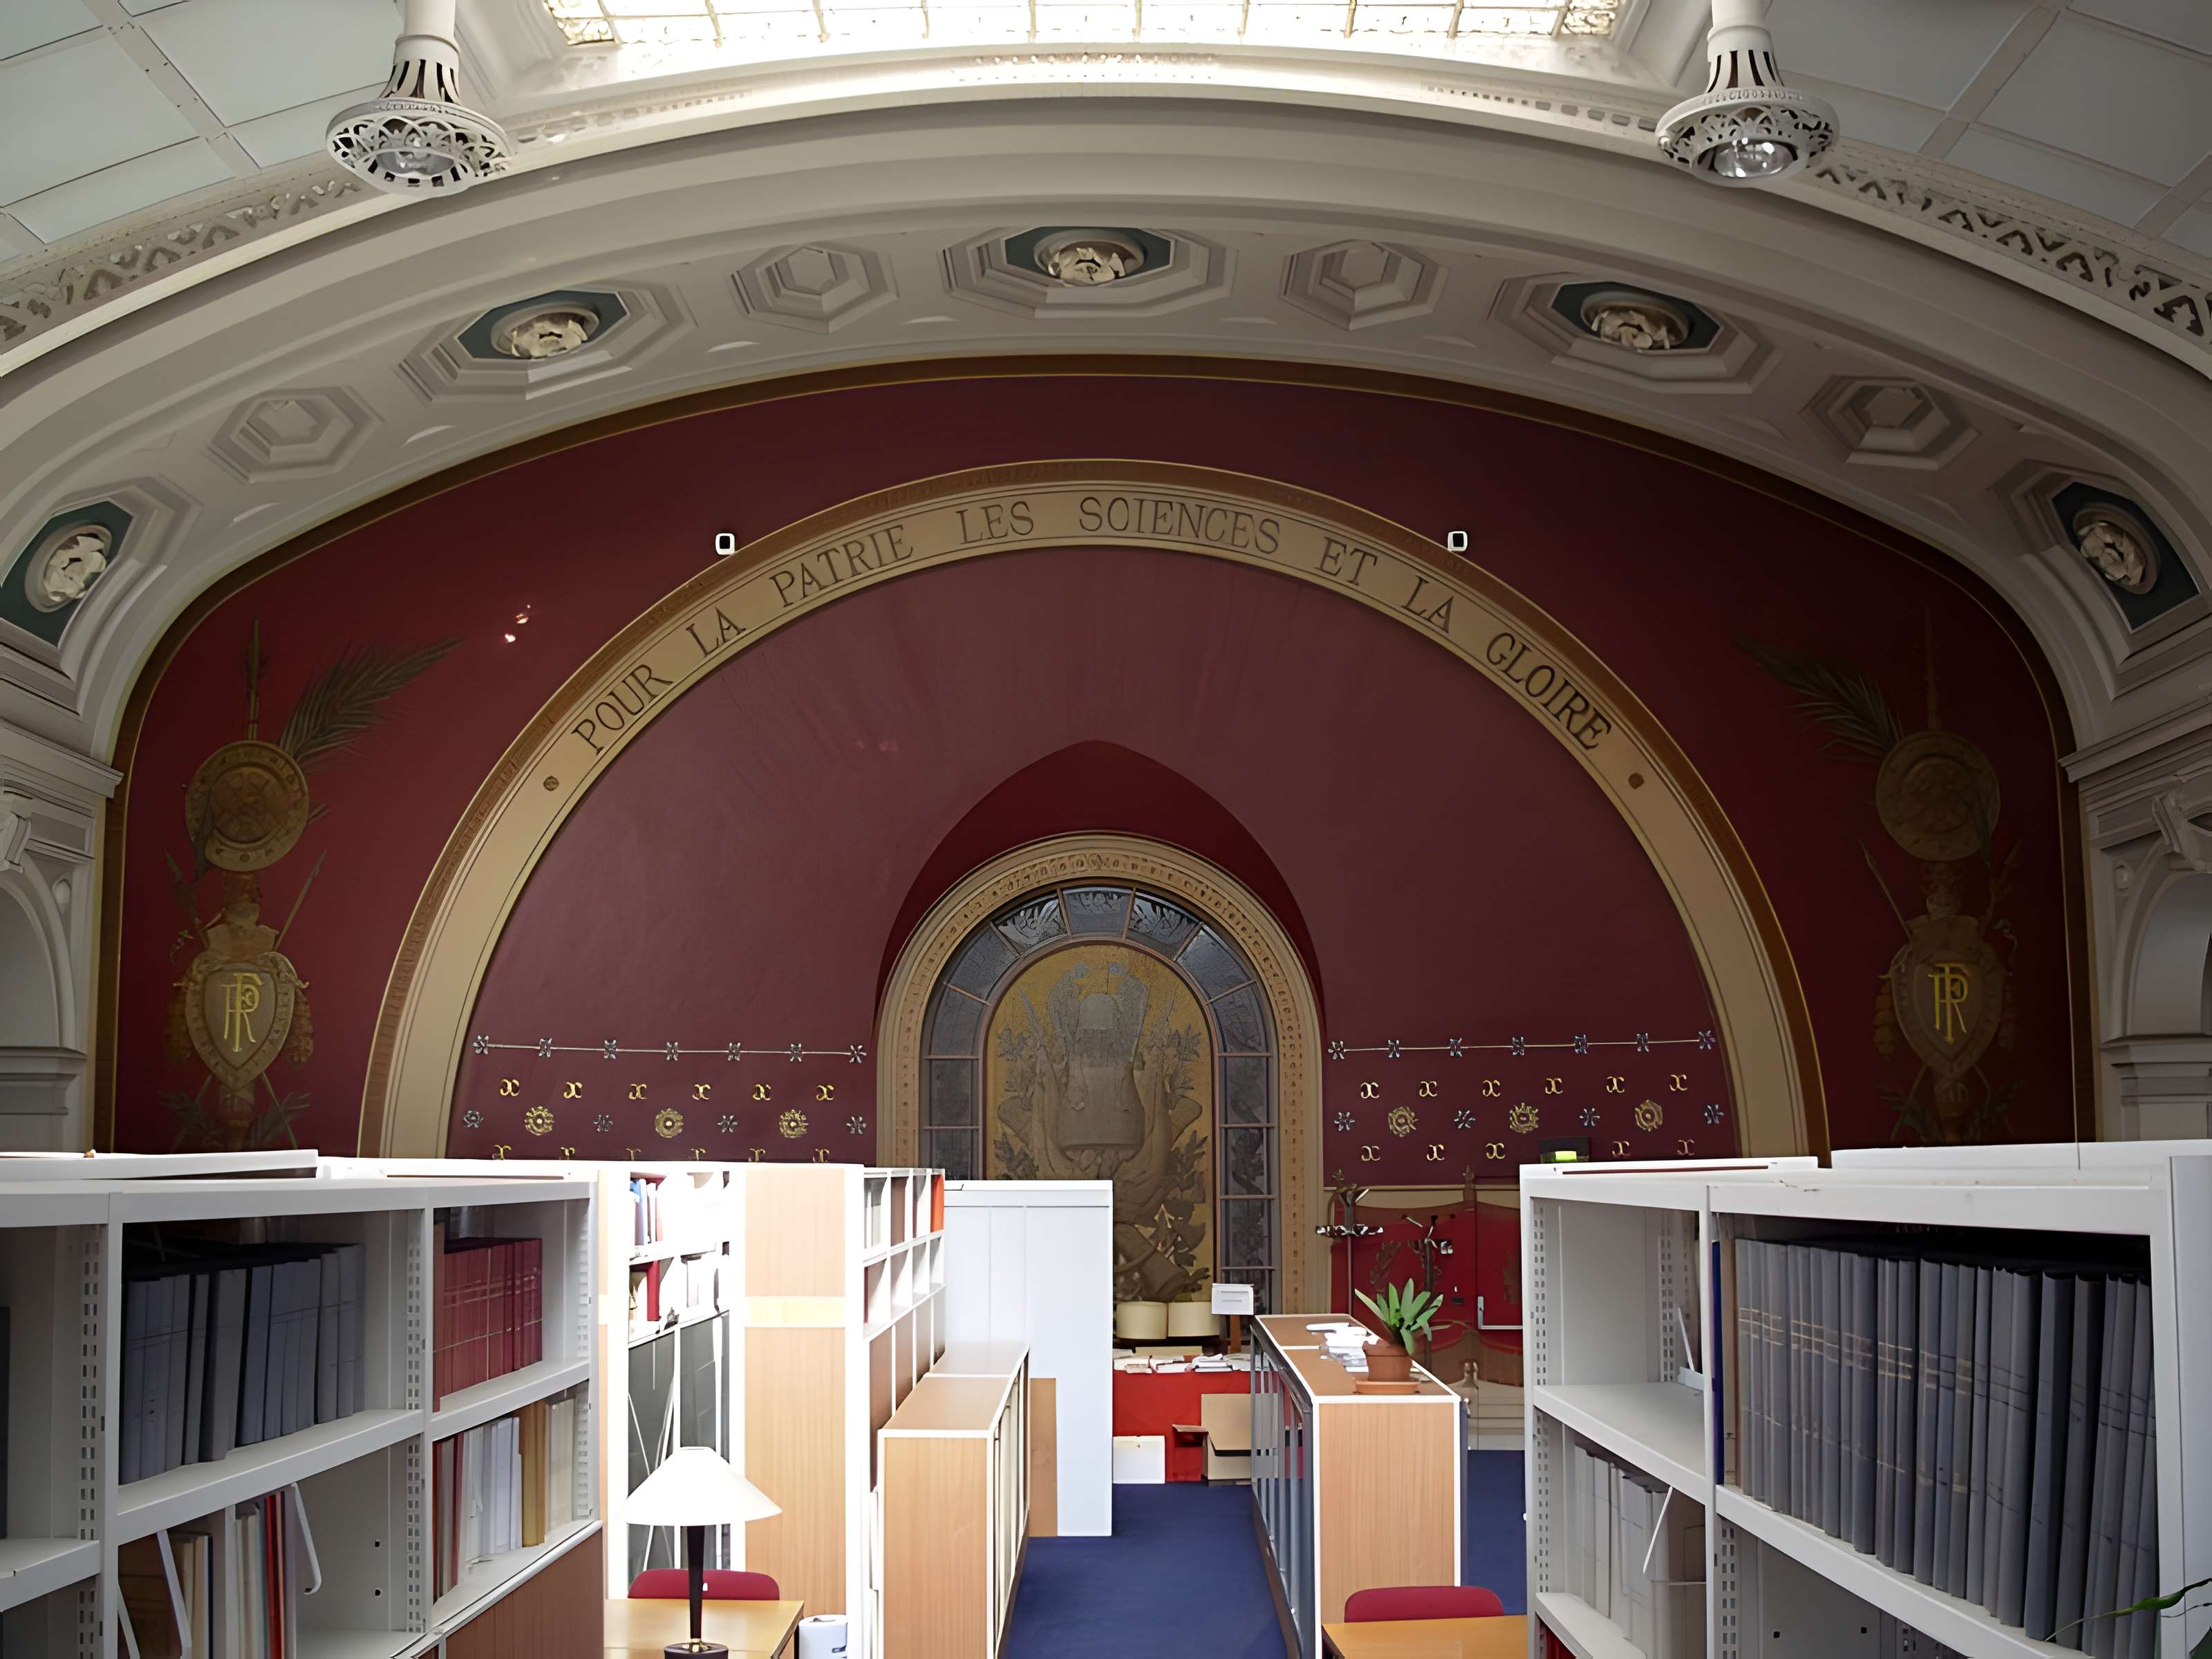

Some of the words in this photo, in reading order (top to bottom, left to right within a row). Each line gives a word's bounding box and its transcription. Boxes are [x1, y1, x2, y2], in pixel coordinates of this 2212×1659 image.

[571, 664, 675, 756] POUR
[686, 607, 747, 657] LA
[769, 525, 913, 608] PATRIE
[955, 501, 1034, 545] LES
[1315, 536, 1378, 586] ET
[1401, 575, 1454, 633] LA
[1487, 632, 1612, 750] GLOIRE
